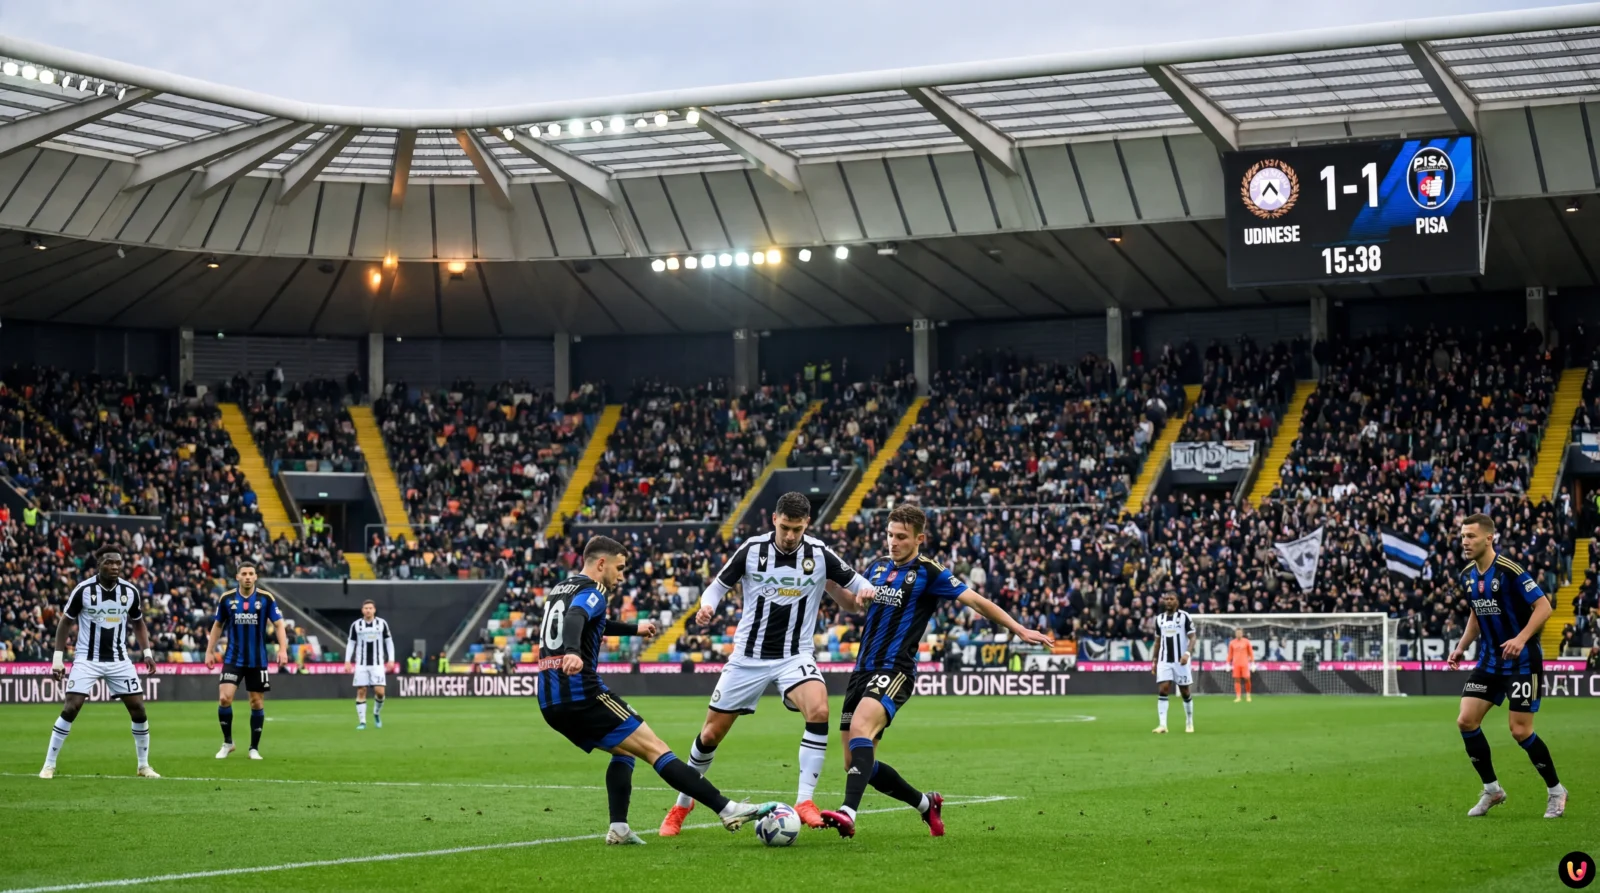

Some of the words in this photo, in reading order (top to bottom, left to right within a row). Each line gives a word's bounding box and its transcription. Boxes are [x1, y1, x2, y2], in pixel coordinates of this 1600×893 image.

[1413, 155, 1449, 169] PISA
[1320, 162, 1379, 210] 1-1
[1415, 216, 1448, 234] PISA
[1244, 225, 1300, 245] UDINESE
[1321, 245, 1381, 274] 15:38
[752, 573, 816, 586] DACIA
[260, 670, 269, 683] 11
[798, 664, 820, 677] 12
[124, 678, 139, 692] 13
[953, 674, 1070, 695] UDINESE.IT
[1511, 682, 1531, 698] 20
